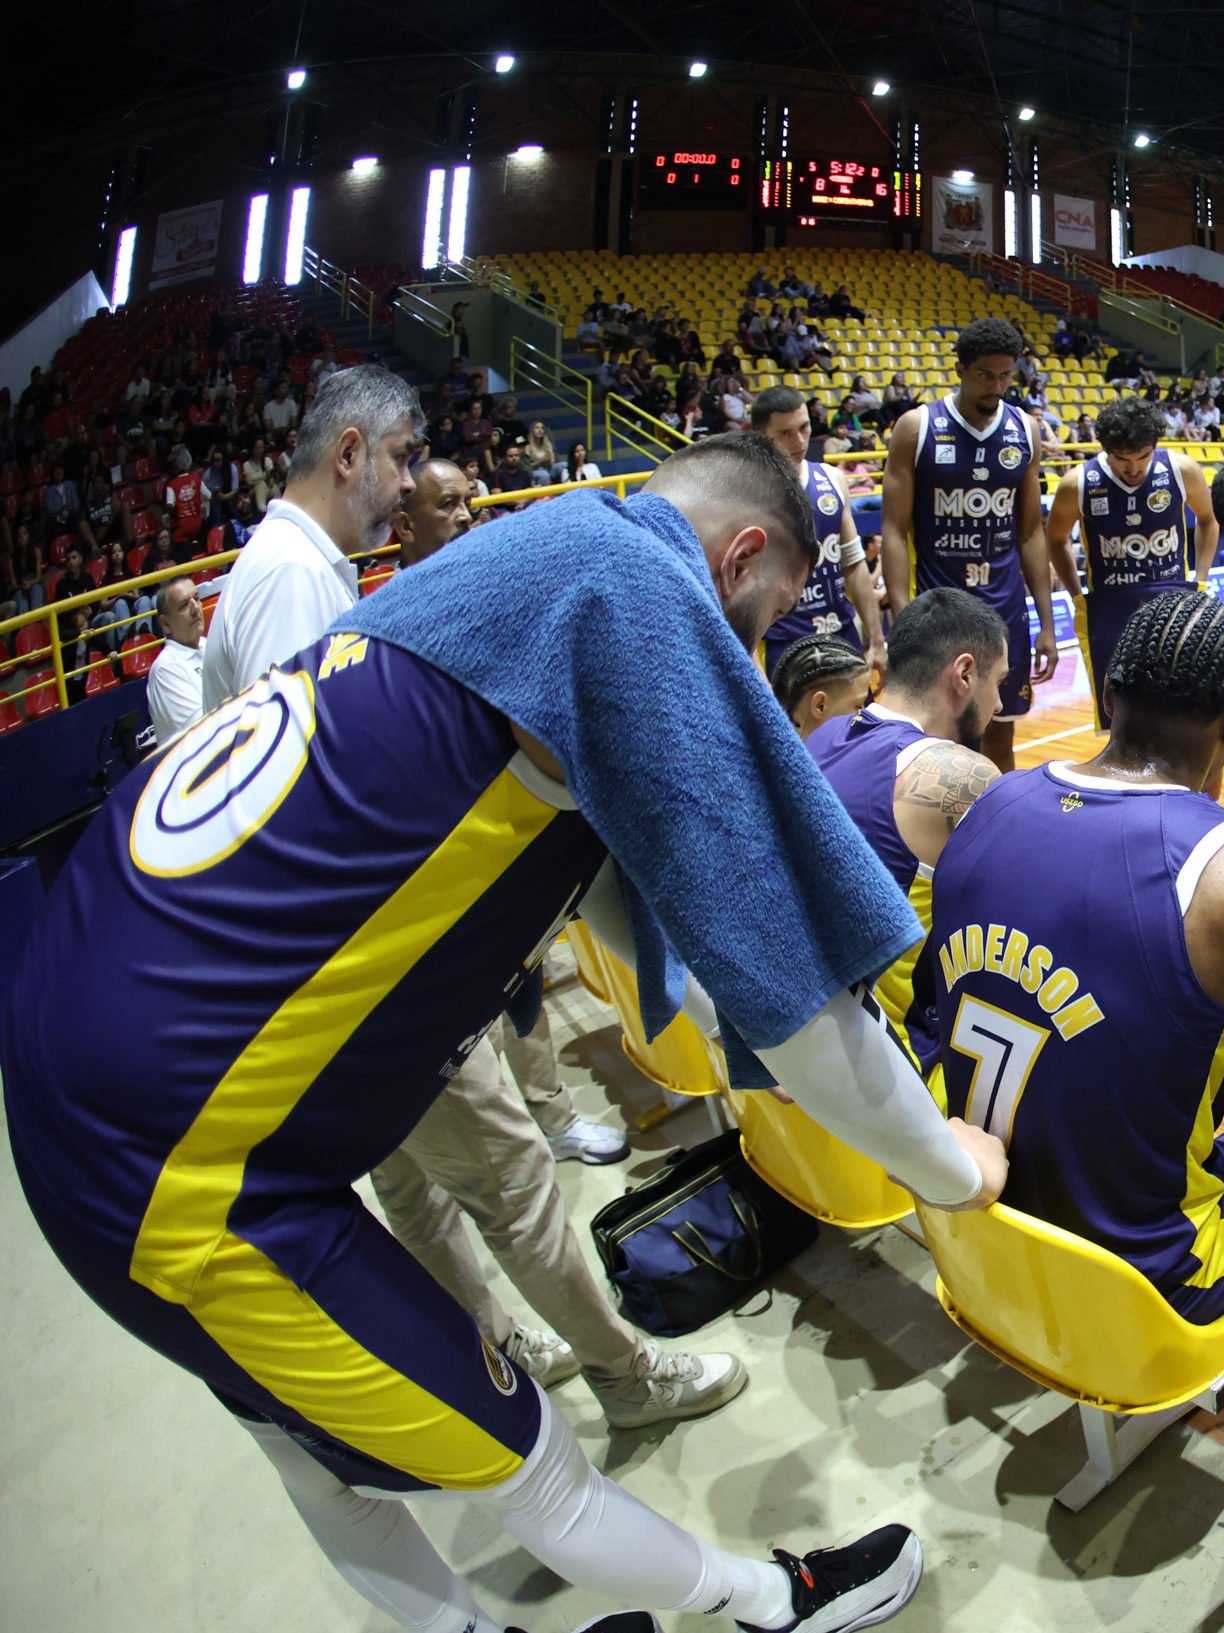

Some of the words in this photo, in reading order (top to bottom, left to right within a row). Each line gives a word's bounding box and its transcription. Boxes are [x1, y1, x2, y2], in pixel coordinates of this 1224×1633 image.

[656, 156, 665, 167] 0
[674, 153, 717, 165] 00:00.0
[731, 158, 740, 169] 0
[667, 173, 676, 184] 0
[731, 174, 740, 185] 0
[815, 178, 825, 191] 8
[875, 183, 887, 196] 16
[1054, 209, 1095, 228] CNA
[934, 487, 1017, 518] MOGI
[950, 534, 982, 548] HIC
[1099, 525, 1179, 560] MOGI
[965, 562, 990, 587] 31
[130, 668, 317, 878] 0
[939, 923, 1105, 1042] ANDERSON
[950, 992, 1052, 1155] 7
